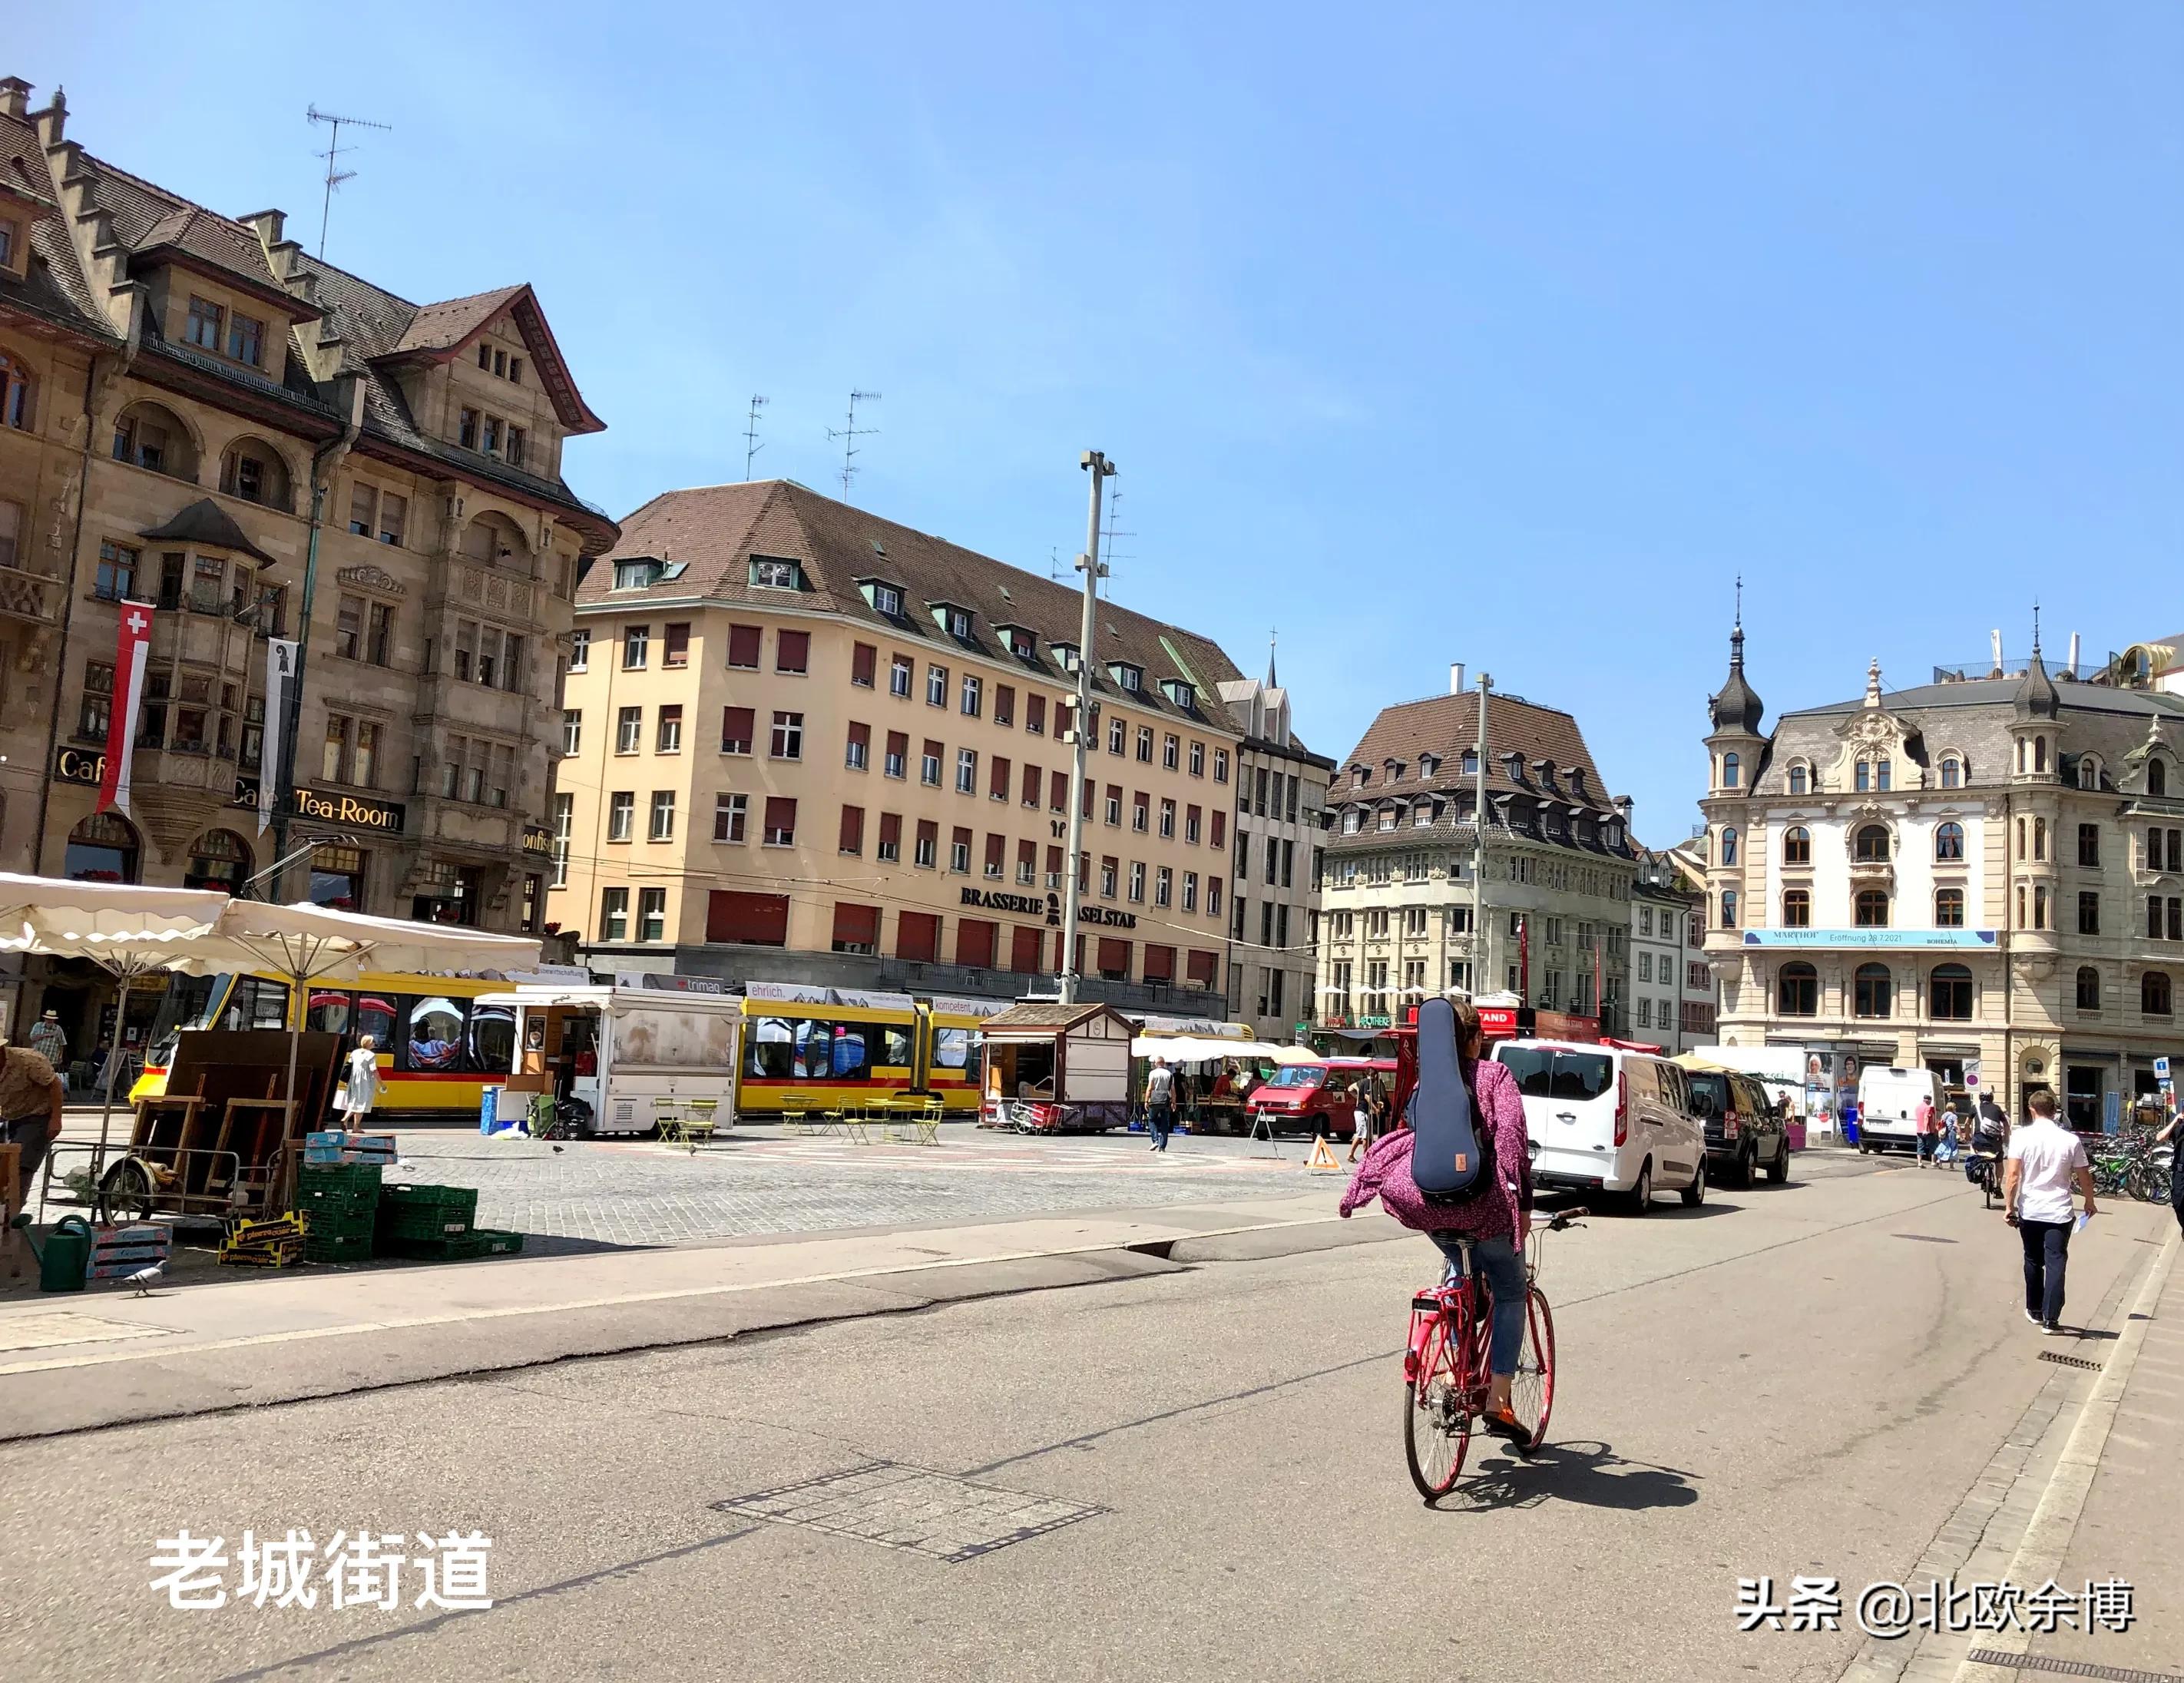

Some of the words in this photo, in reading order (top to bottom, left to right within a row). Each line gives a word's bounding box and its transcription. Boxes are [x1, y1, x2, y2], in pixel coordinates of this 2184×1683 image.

[296, 790, 399, 830] Tea-Room
[961, 887, 1044, 915] BRASSERIE
[1064, 903, 1137, 929] ASELSTAB
[1830, 934, 1866, 943] Eröffnung
[752, 986, 786, 999] ehrlich.
[935, 999, 972, 1013] kompetent.
[1359, 1016, 1390, 1026] APOTHEKE
[1478, 1013, 1507, 1022] AND
